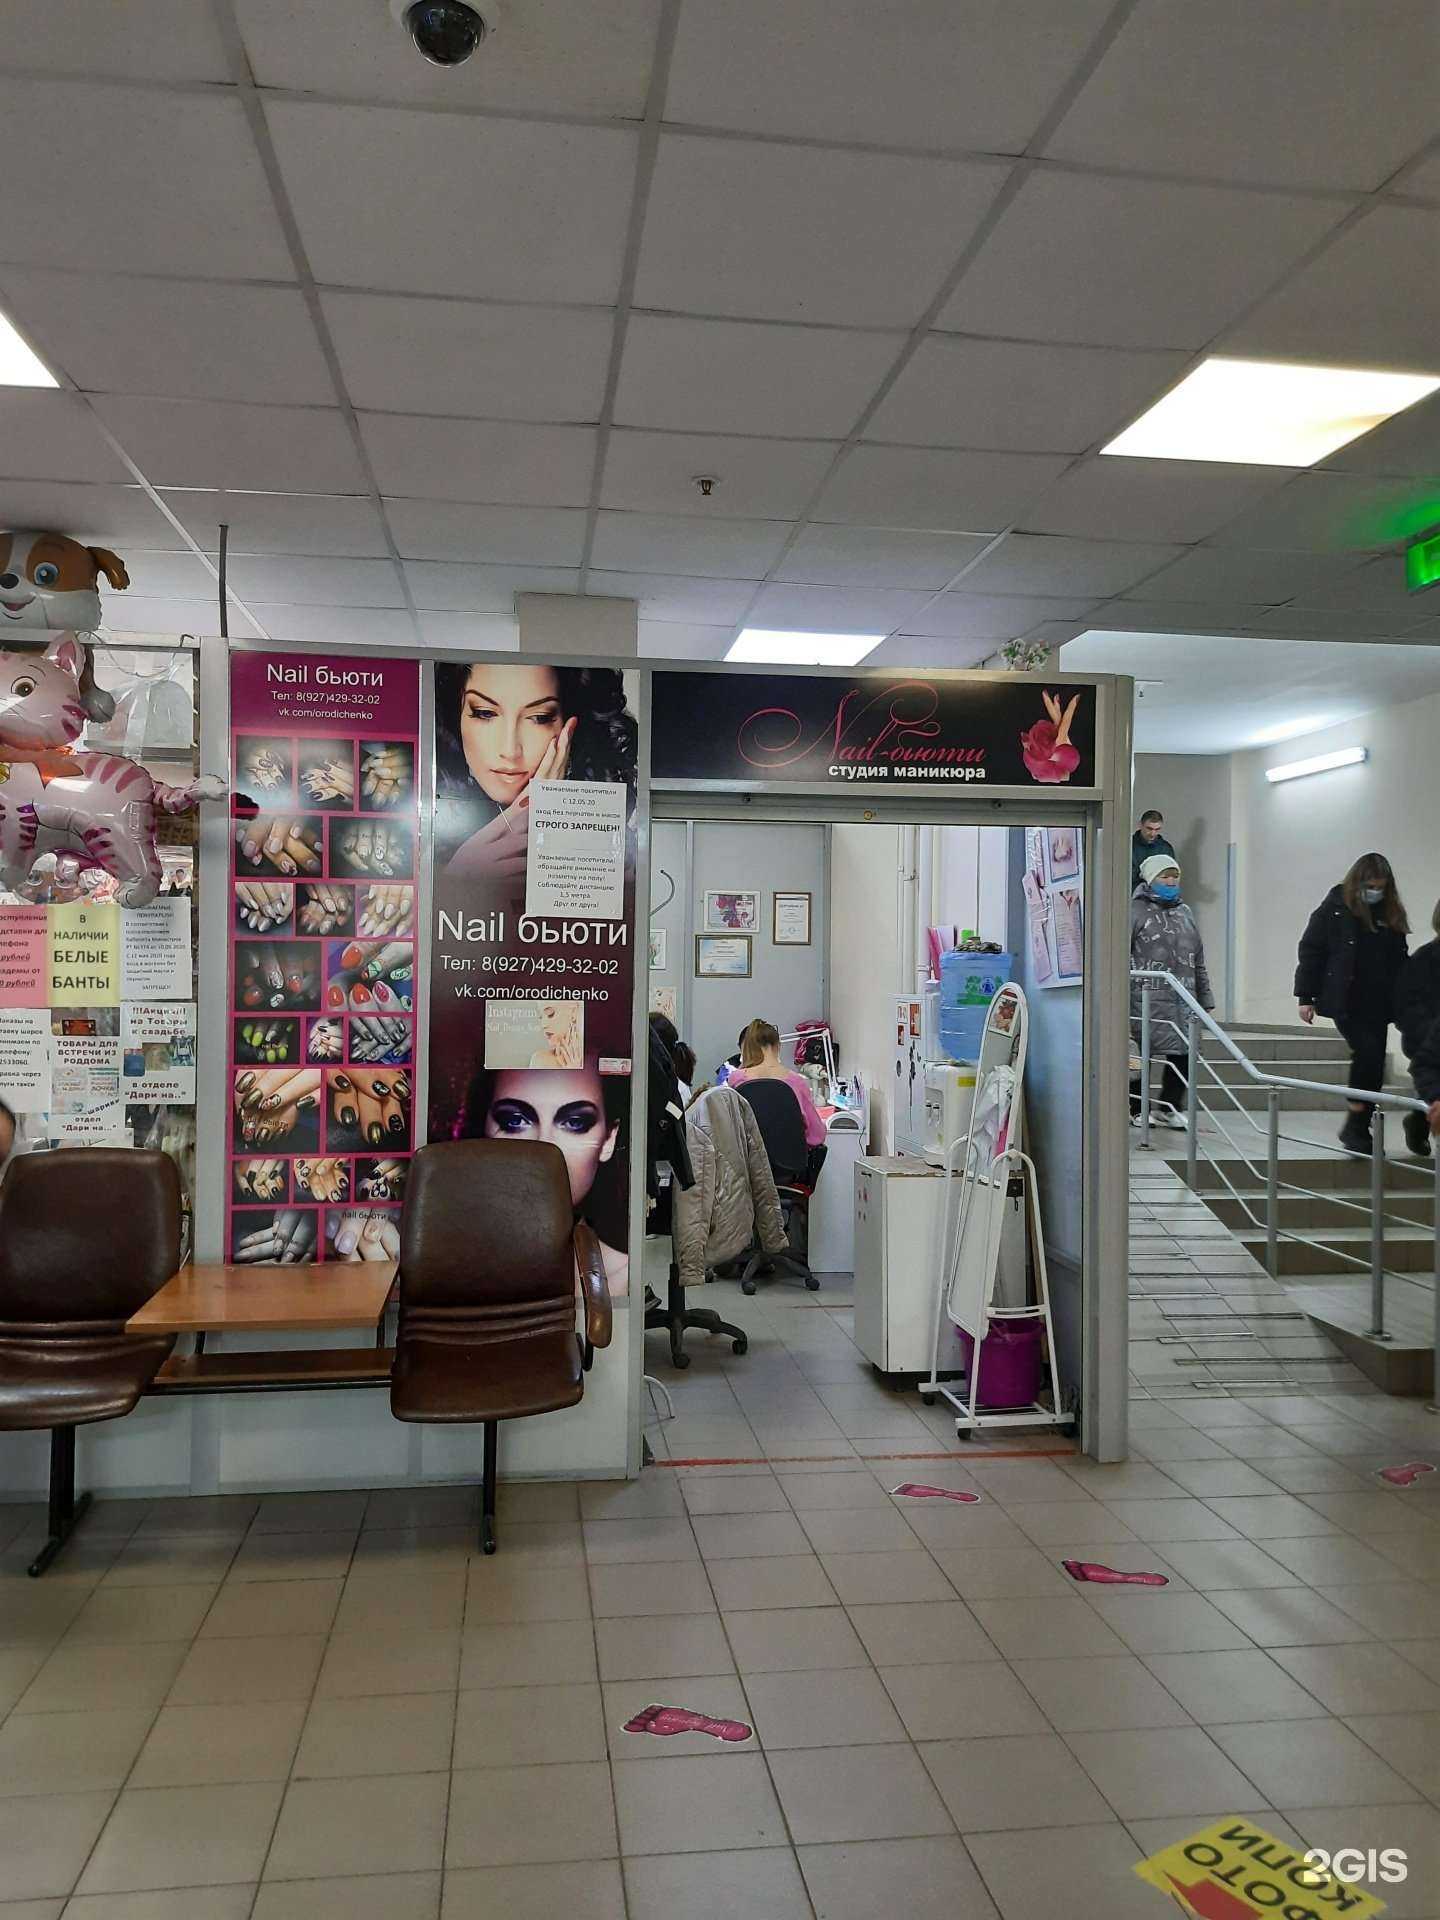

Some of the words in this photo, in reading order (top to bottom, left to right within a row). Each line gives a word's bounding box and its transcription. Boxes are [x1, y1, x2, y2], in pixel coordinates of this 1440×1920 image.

[267, 664, 307, 683] Nail
[316, 666, 383, 686] бьюти
[272, 691, 293, 701] Тел:
[296, 692, 380, 705] 8(927)429-32-02
[278, 708, 373, 719] vk.com/orodichenko
[828, 765, 888, 778] студия
[894, 766, 986, 781] маникюра
[535, 820, 569, 830] СТРОГО
[570, 822, 620, 832] ЗАПРЕЩЕН!
[80, 914, 87, 924] В
[438, 910, 504, 942] Nail
[518, 912, 627, 946] бьюти
[54, 931, 109, 941] НАЛИЧИИ
[53, 950, 109, 964] БЕЛЫЕ
[440, 955, 476, 971] Тел:
[481, 956, 619, 975] 8(927)429-32-02
[52, 976, 109, 989] БАНТЫ
[454, 984, 609, 1000] vk.com/orodichenko
[141, 1028, 186, 1036] свадьбе
[57, 1040, 96, 1048] ТОВАРЫ
[99, 1040, 119, 1049] ДЛЯ
[63, 1057, 111, 1065] РОДДОМА
